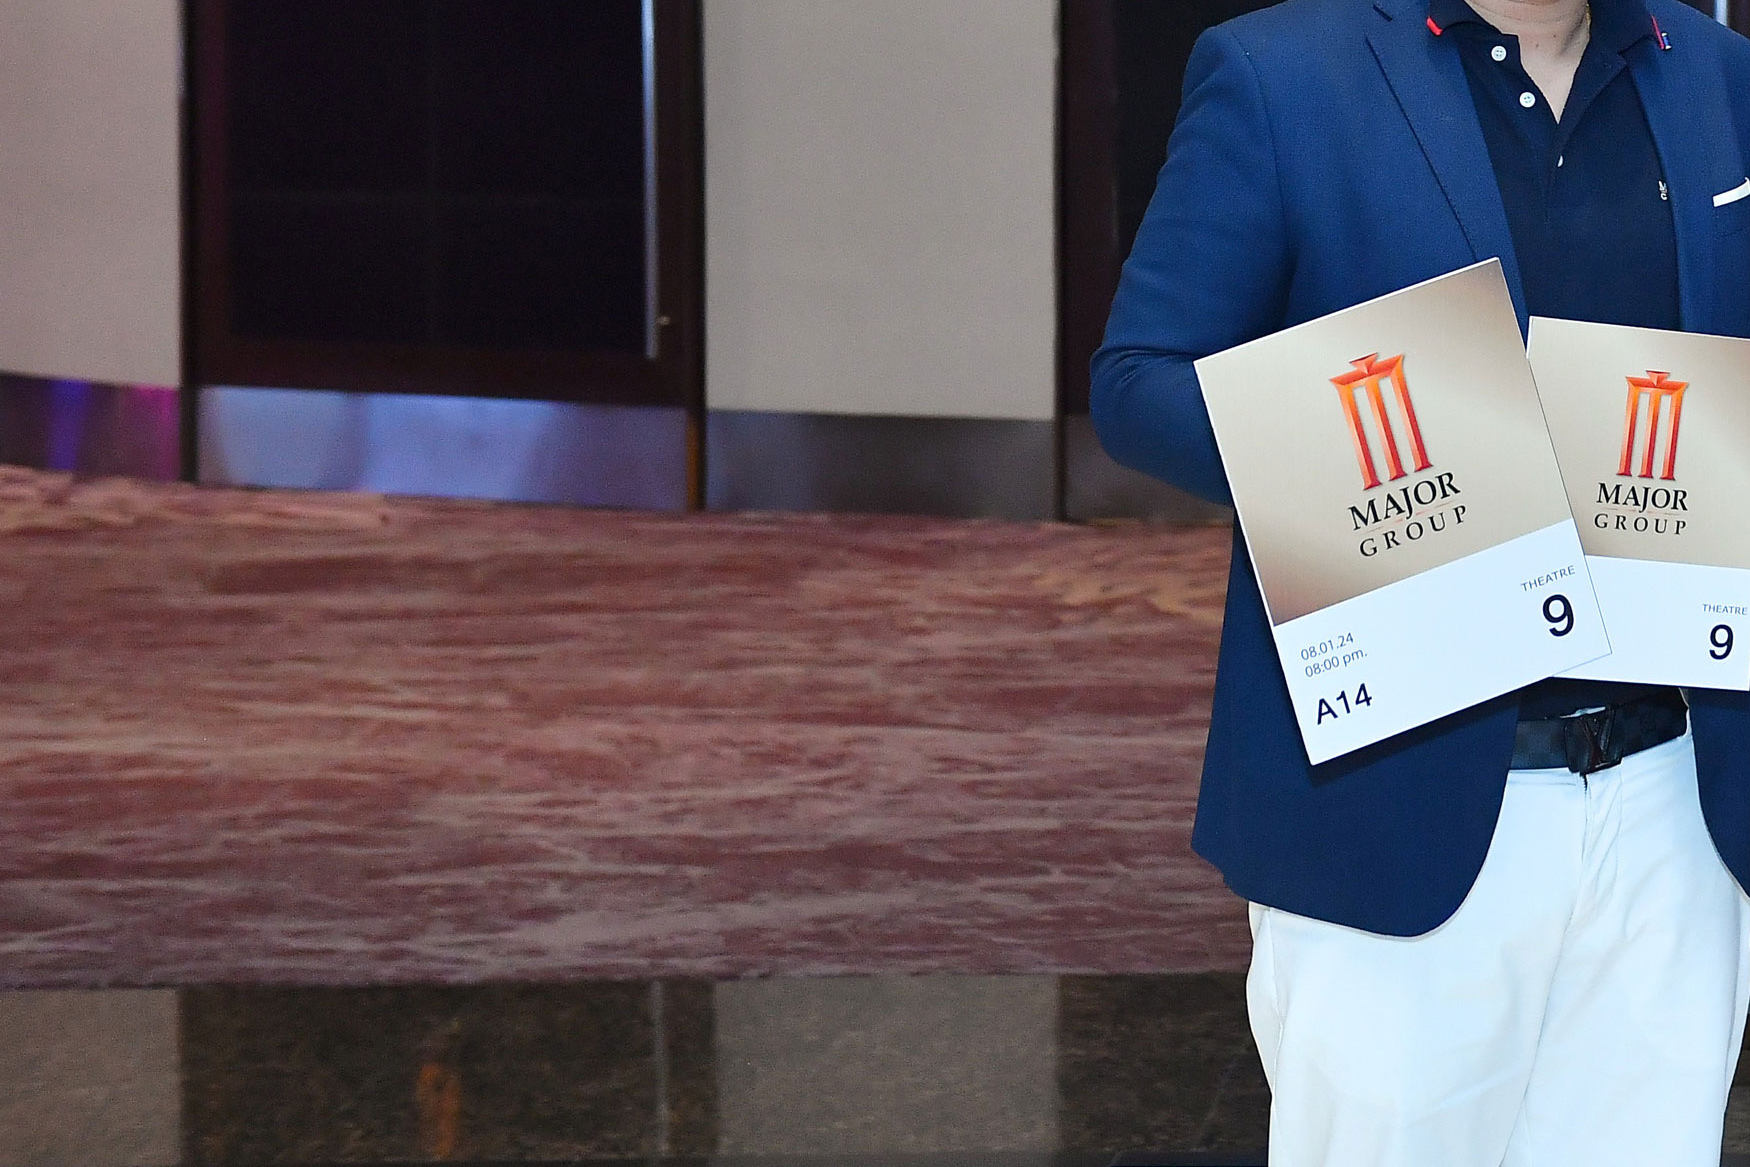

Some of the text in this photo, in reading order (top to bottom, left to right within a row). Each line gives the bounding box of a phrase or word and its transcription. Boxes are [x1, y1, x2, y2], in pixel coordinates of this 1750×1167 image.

[1348, 471, 1461, 531] MAJOR
[1596, 482, 1689, 514] MAJOR
[1359, 504, 1467, 558] GROUP
[1594, 512, 1687, 535] GROUP
[1520, 564, 1576, 593] THEATRE
[1542, 594, 1575, 637] 9
[1702, 603, 1748, 616] THEATRE
[1300, 632, 1354, 661] 08.01.24
[1709, 624, 1734, 660] 9
[1305, 649, 1368, 678] 08:00 pm.
[1317, 682, 1373, 726] A14
